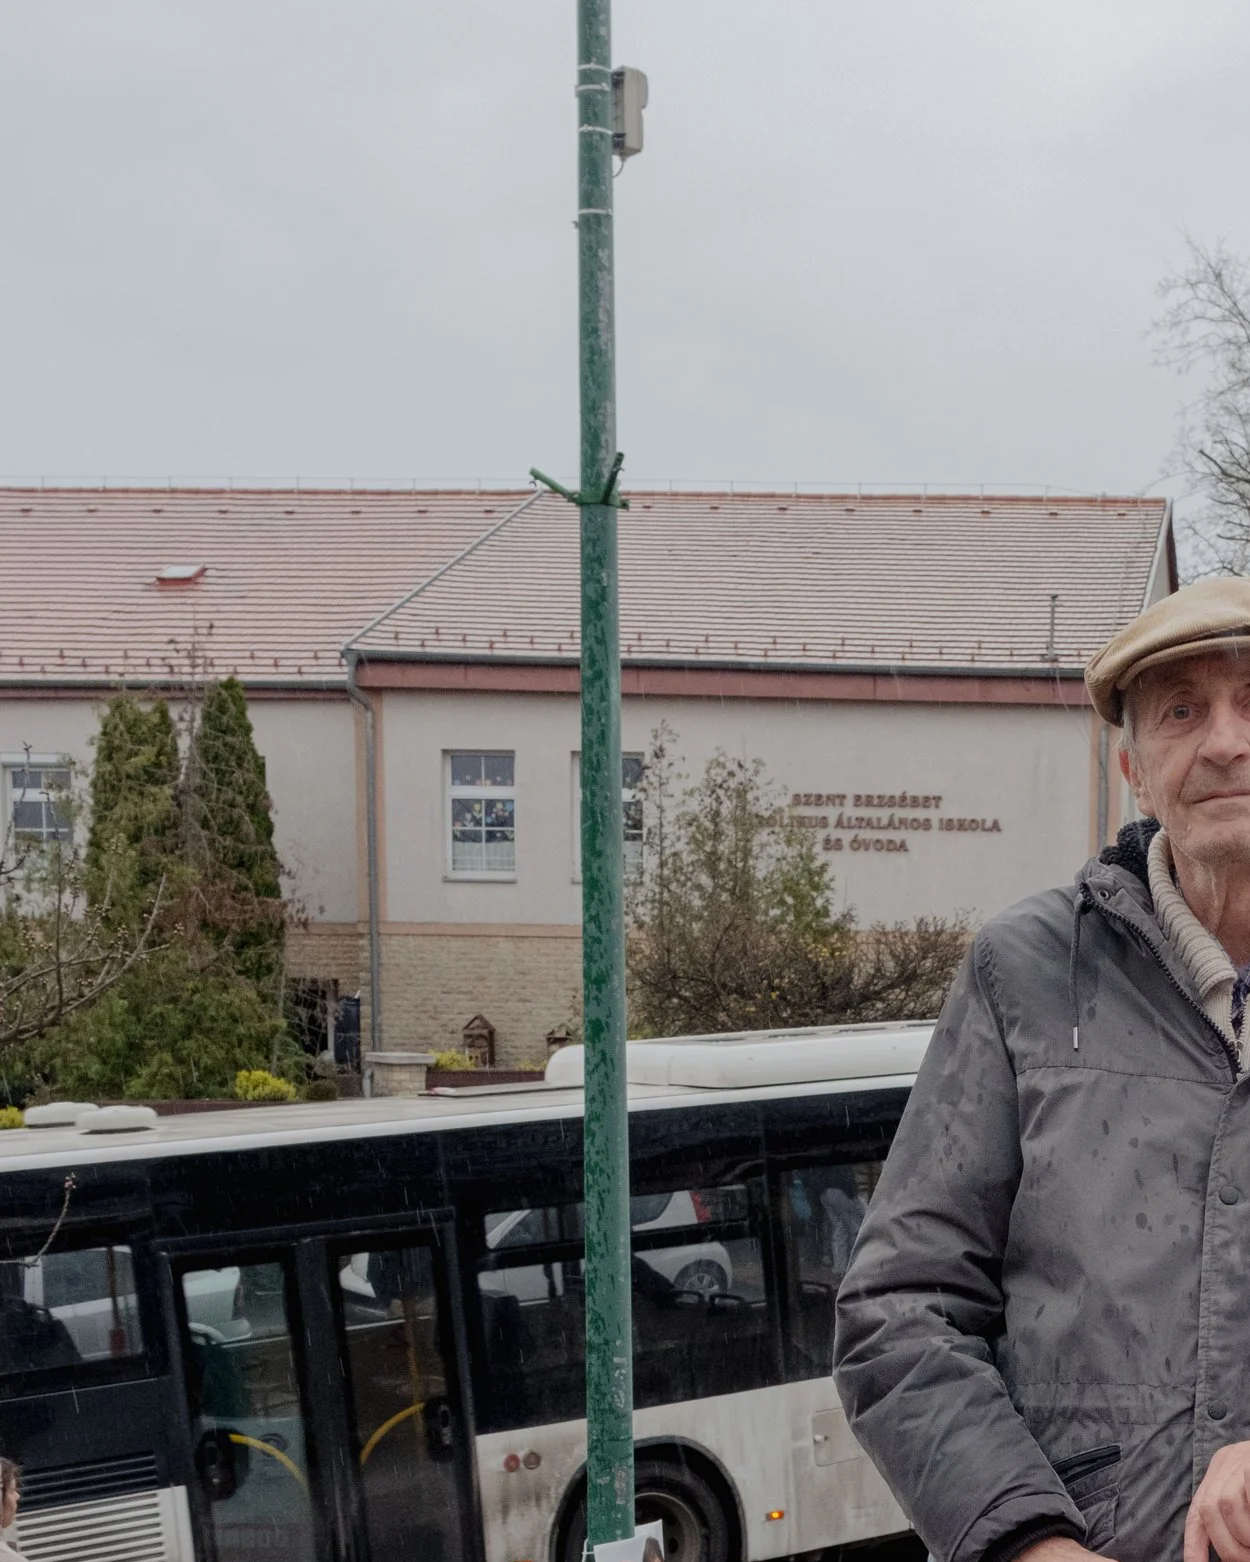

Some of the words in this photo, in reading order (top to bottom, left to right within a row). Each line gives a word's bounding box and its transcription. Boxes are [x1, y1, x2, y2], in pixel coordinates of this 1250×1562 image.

[792, 793, 847, 807] SZENT
[853, 791, 943, 809] ERZSÉBET
[740, 814, 829, 829] OLIKUS
[834, 811, 932, 831] ÁLTALÁNOS
[938, 817, 1002, 833] ISKOLA
[822, 833, 844, 851] ÉS
[850, 833, 909, 853] ÓVODA
